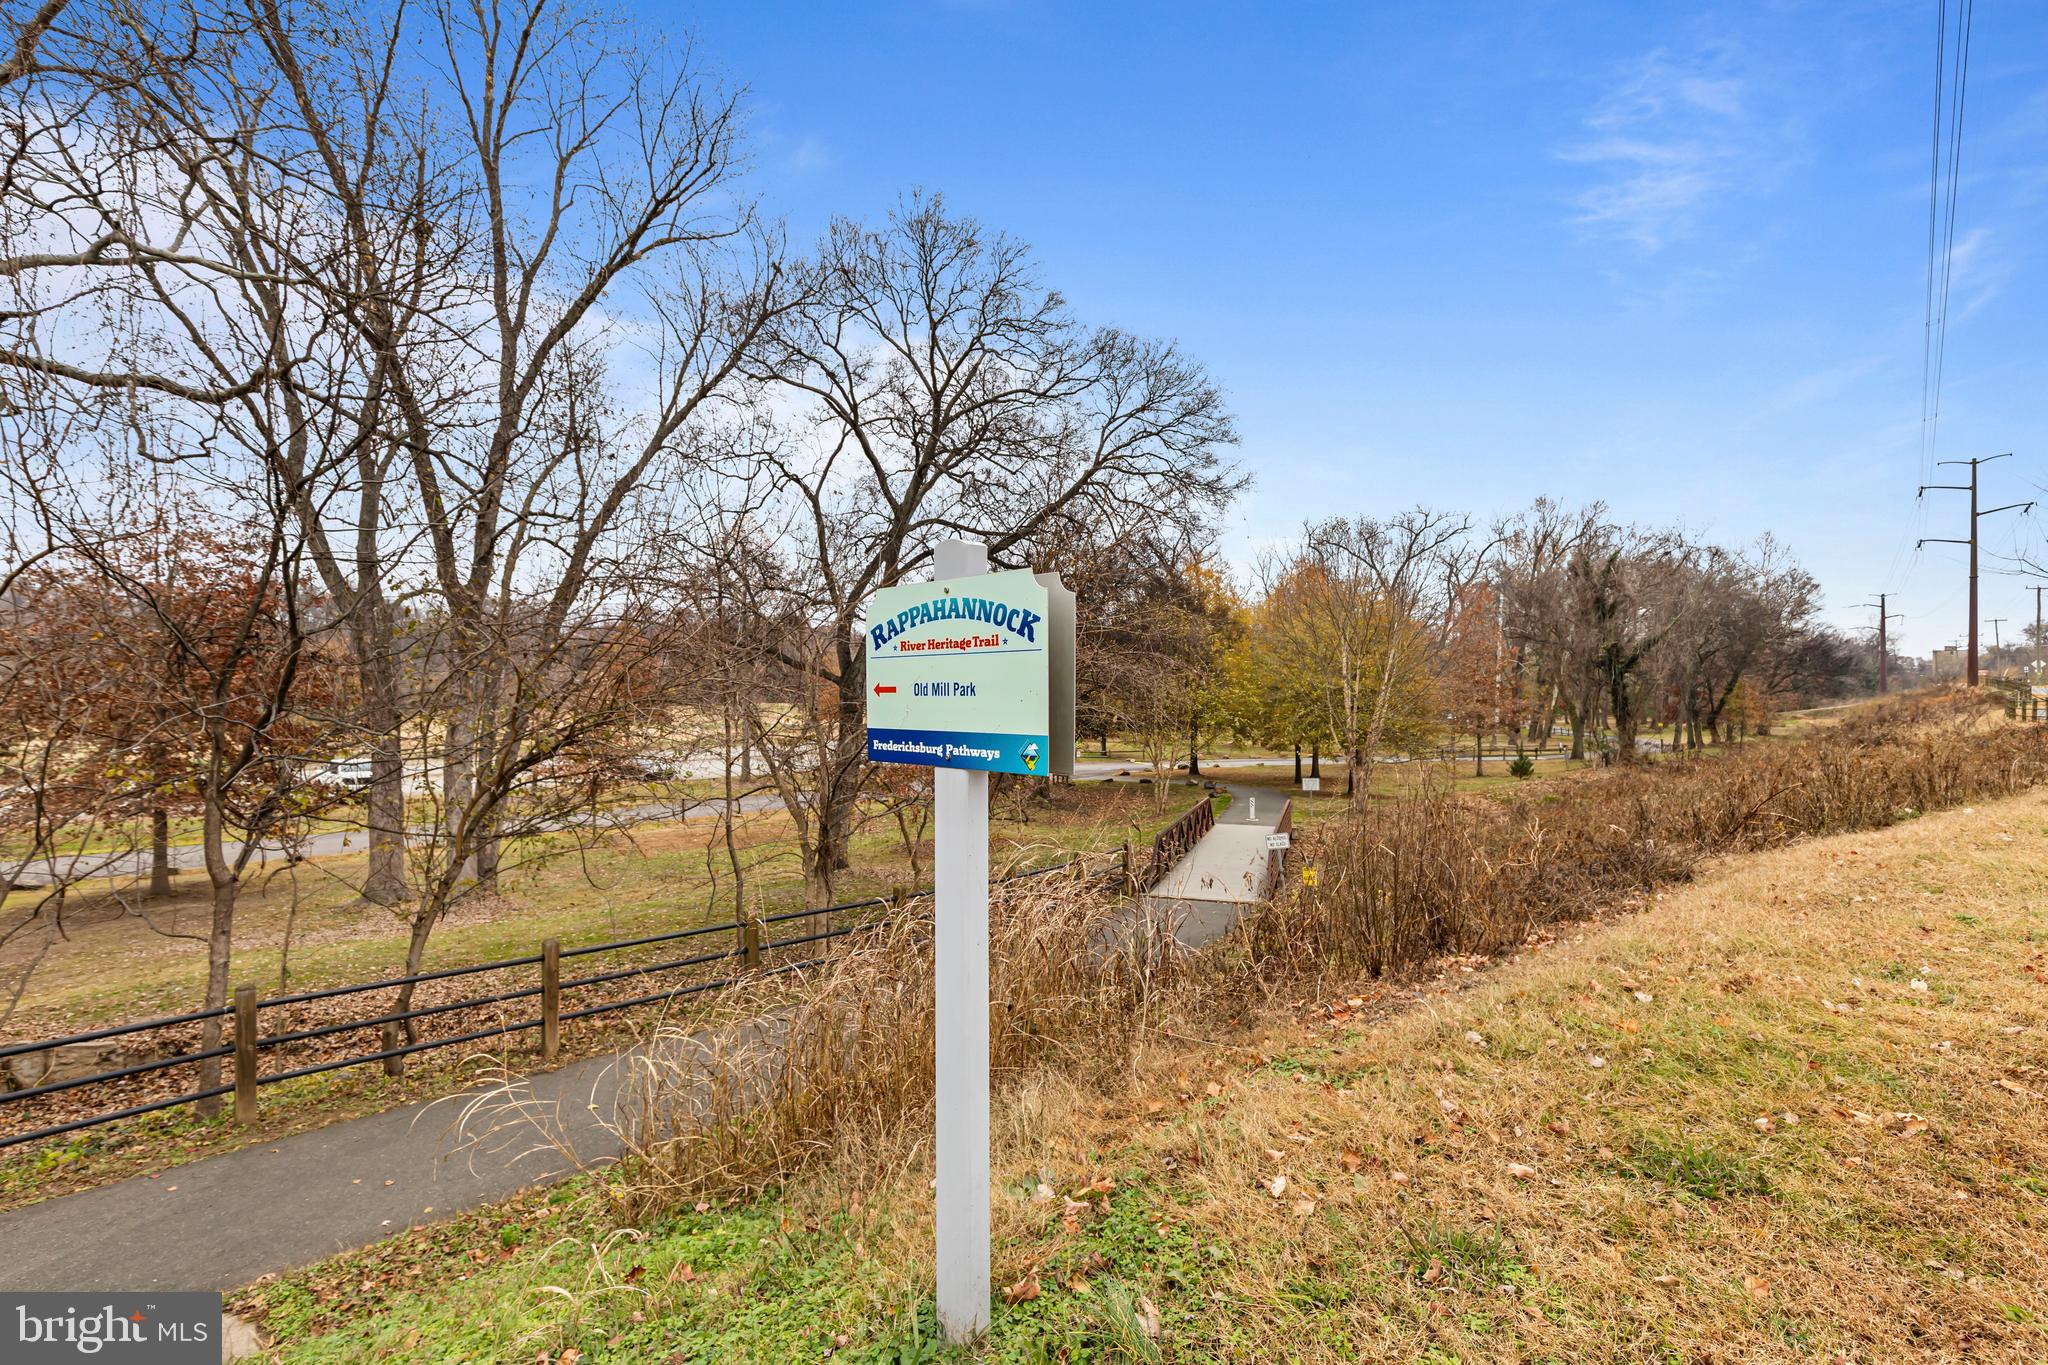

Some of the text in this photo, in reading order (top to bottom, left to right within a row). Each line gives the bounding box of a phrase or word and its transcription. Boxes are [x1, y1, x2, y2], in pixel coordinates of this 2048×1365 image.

[870, 597, 1041, 651] RAPPAHANNOCK
[900, 634, 999, 652] River Heritage Trail
[913, 682, 977, 697] Old Mill Park
[945, 744, 1000, 761] Pathways
